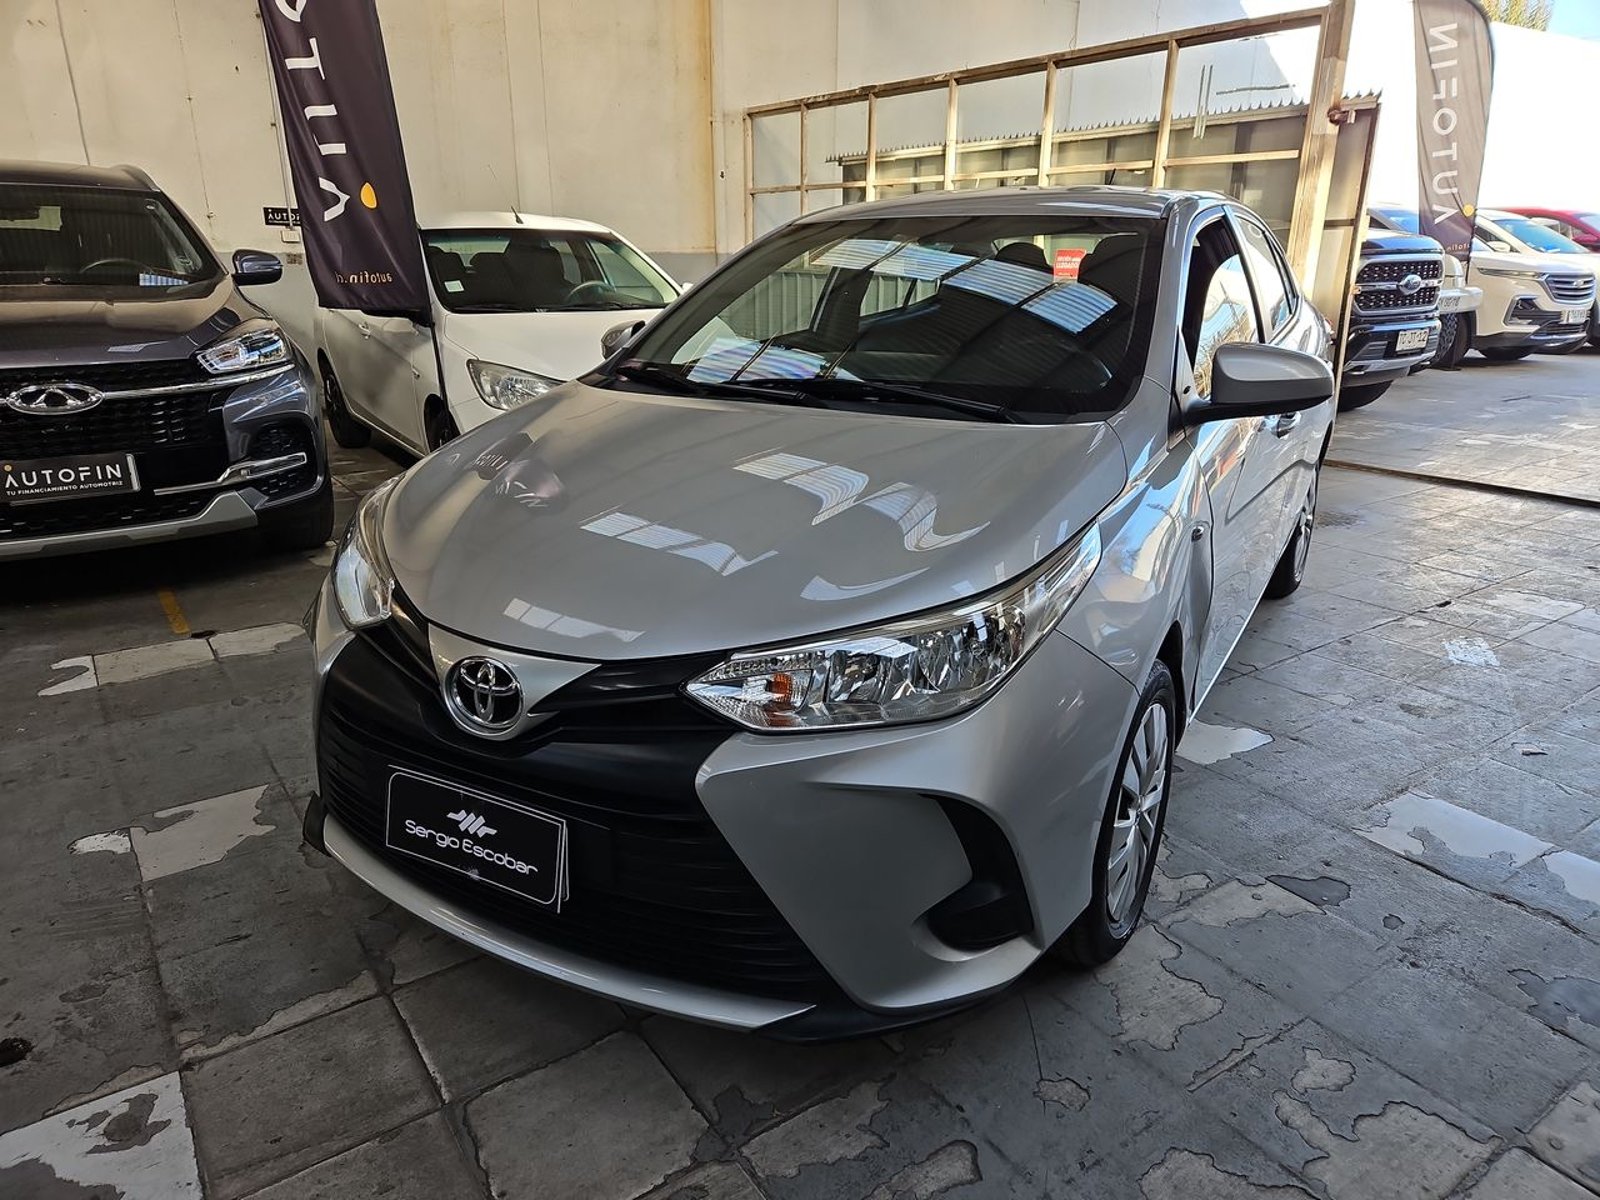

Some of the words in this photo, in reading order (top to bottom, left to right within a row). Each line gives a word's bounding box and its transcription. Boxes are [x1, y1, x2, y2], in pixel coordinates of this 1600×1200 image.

[5, 464, 122, 489] AUTOFIN
[18, 484, 78, 495] FINANCIAMIENTO
[461, 838, 539, 875] Escobar
